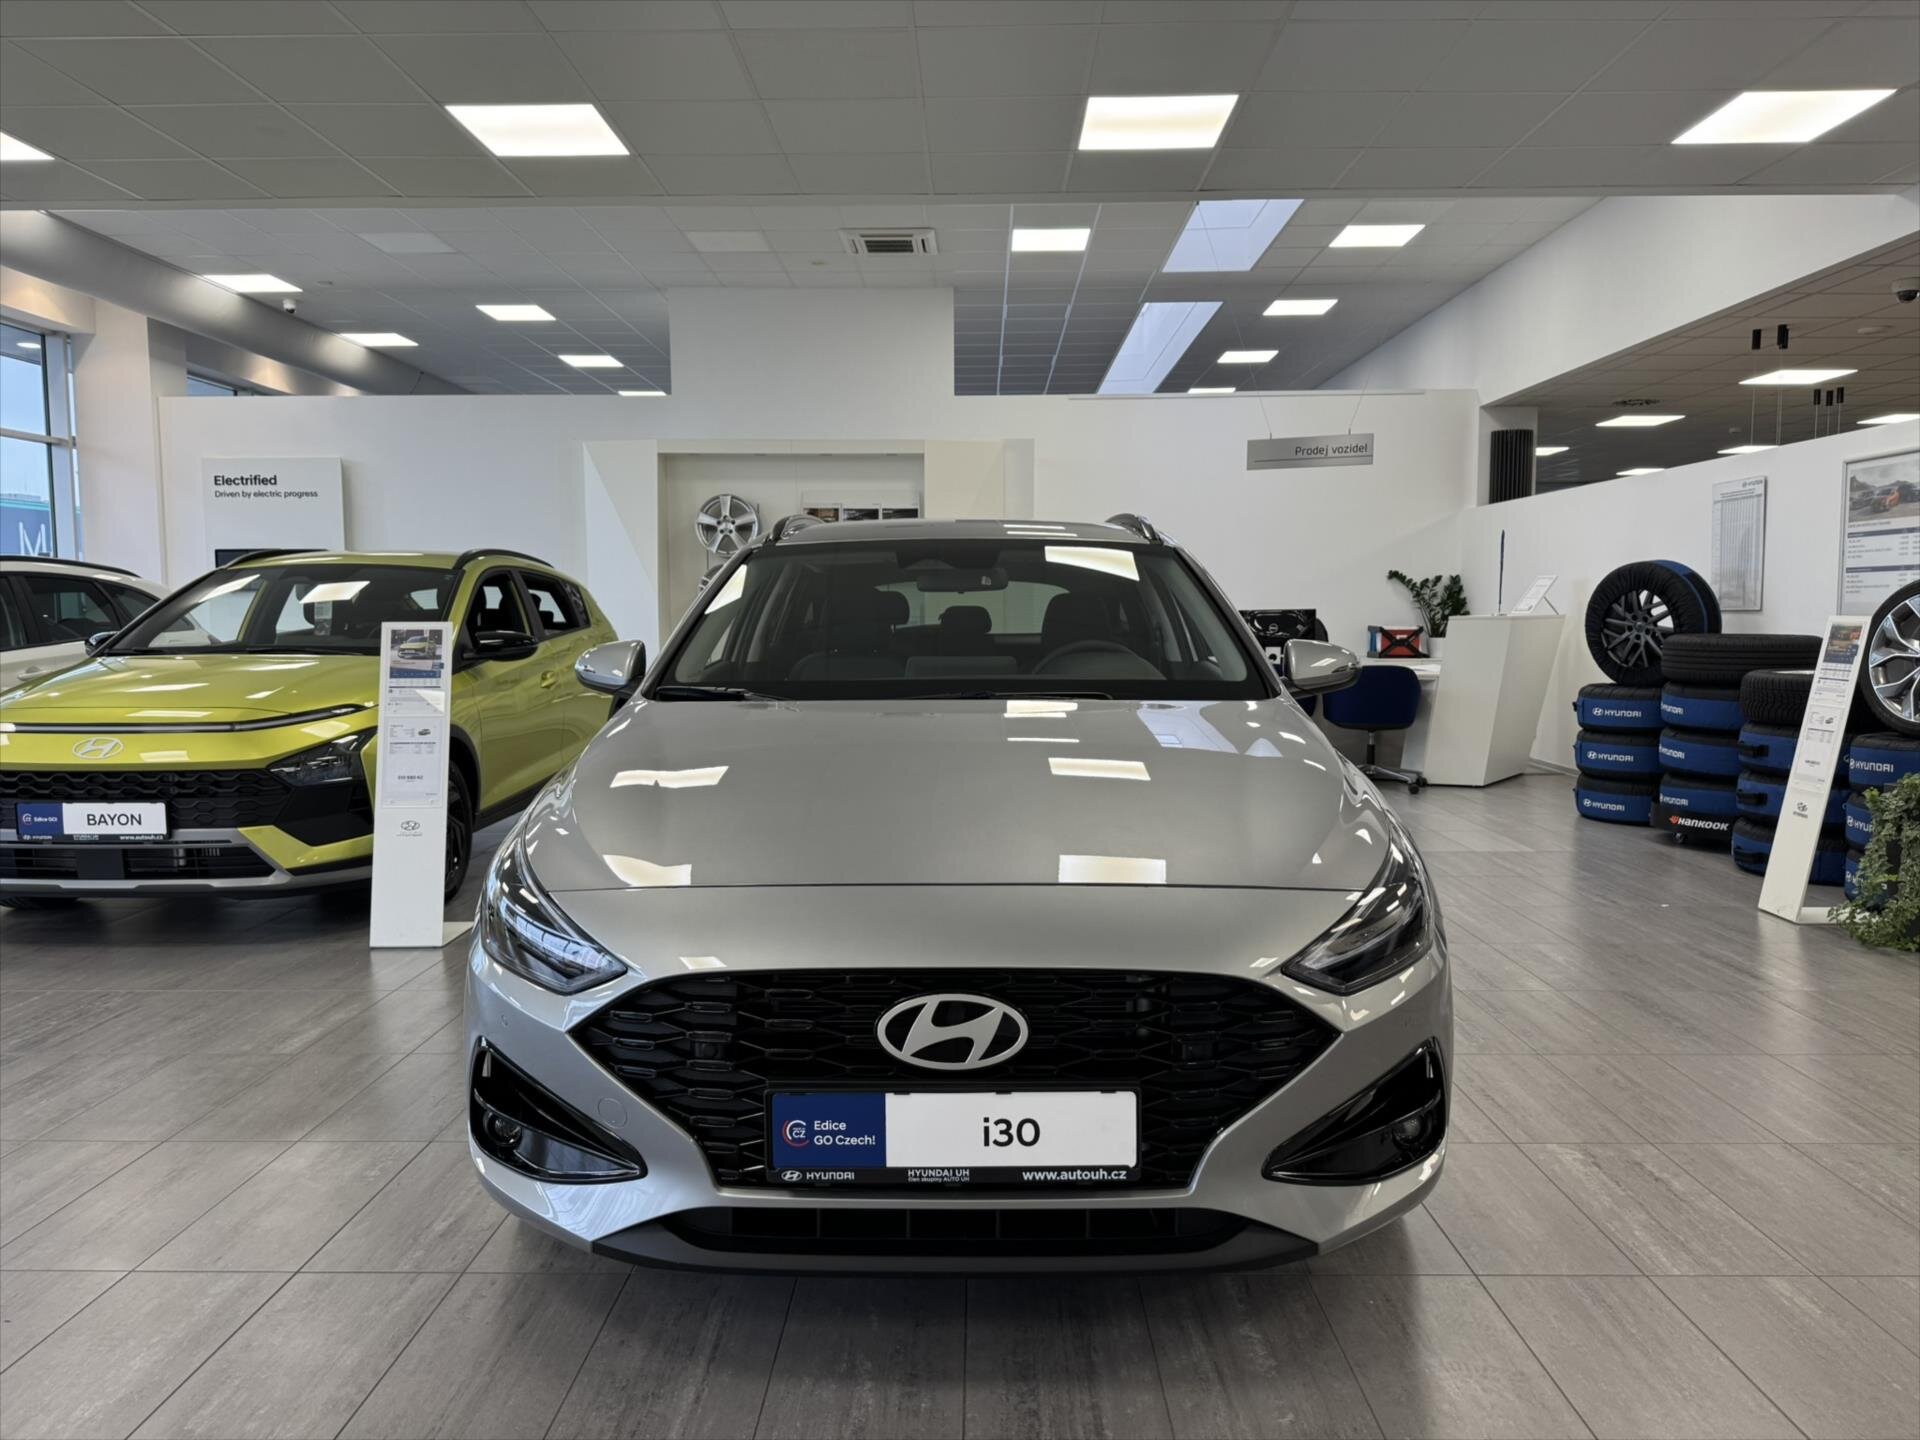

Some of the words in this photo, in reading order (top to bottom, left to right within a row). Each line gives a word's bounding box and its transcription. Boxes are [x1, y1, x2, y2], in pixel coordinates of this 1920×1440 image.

[1295, 444, 1329, 456] Prodej
[1331, 443, 1368, 455] vozidel
[214, 474, 277, 486] Electrified
[214, 490, 240, 498] Driven
[241, 490, 252, 499] by
[253, 490, 282, 498] electric
[283, 491, 318, 499] progress
[1604, 710, 1642, 718] HYUNDAI
[1598, 753, 1634, 762] HYUNDAI
[1855, 760, 1894, 773] HYUNDAI
[1592, 802, 1625, 811] HYUNDAI
[87, 813, 142, 826] BAYON
[814, 1120, 847, 1131] Edice
[983, 1116, 1041, 1148] i30
[813, 1135, 833, 1146] GO
[835, 1135, 876, 1146] Czech!
[806, 1171, 855, 1181] HYUNDAI
[907, 1168, 953, 1177] HYUNDAI
[955, 1168, 970, 1177] UH
[1022, 1169, 1128, 1181] www.autouh.cz
